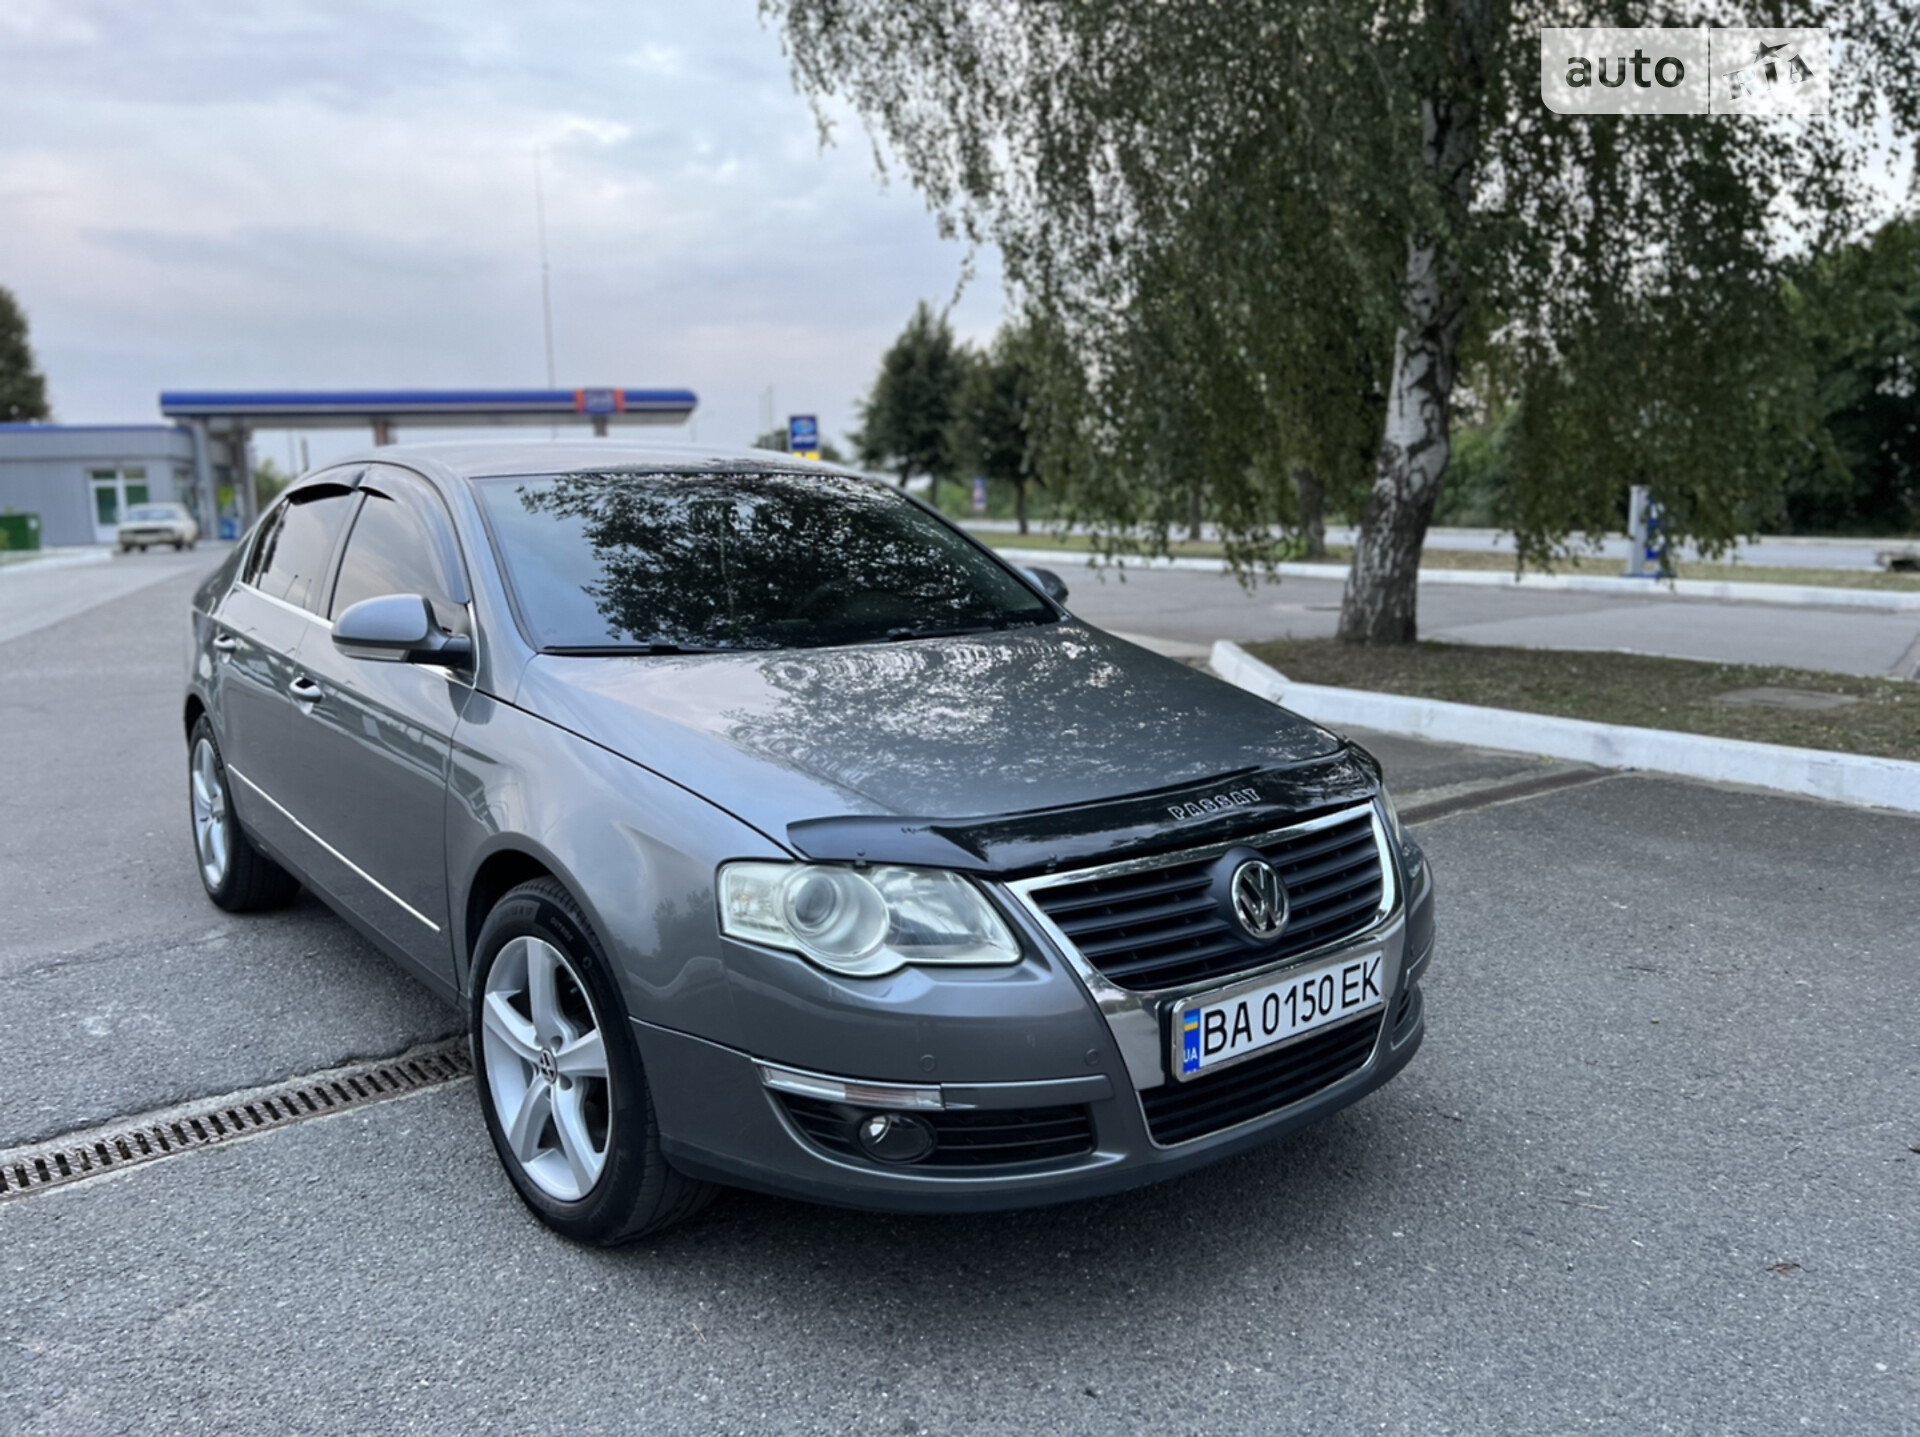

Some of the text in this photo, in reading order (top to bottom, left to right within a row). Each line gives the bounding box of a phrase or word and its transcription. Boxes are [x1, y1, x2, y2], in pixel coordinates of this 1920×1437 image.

[1167, 788, 1261, 820] PASSAT
[1204, 956, 1381, 1057] BA 0150 EK
[1183, 1047, 1198, 1063] UA
